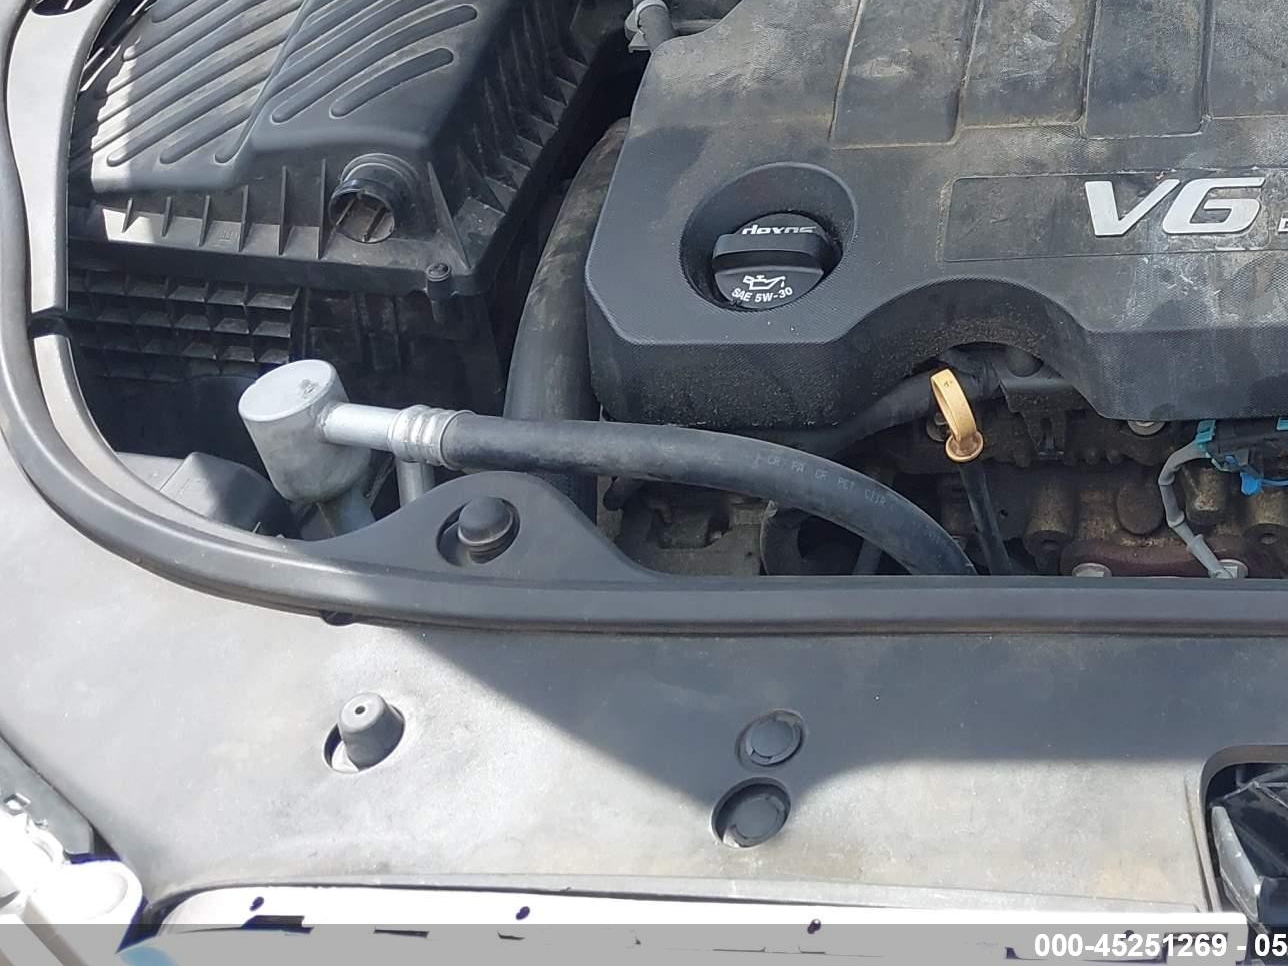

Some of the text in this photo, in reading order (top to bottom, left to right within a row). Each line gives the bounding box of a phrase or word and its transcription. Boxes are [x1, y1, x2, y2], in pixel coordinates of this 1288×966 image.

[1084, 176, 1266, 237] V6
[731, 286, 793, 303] SAE 5W-30
